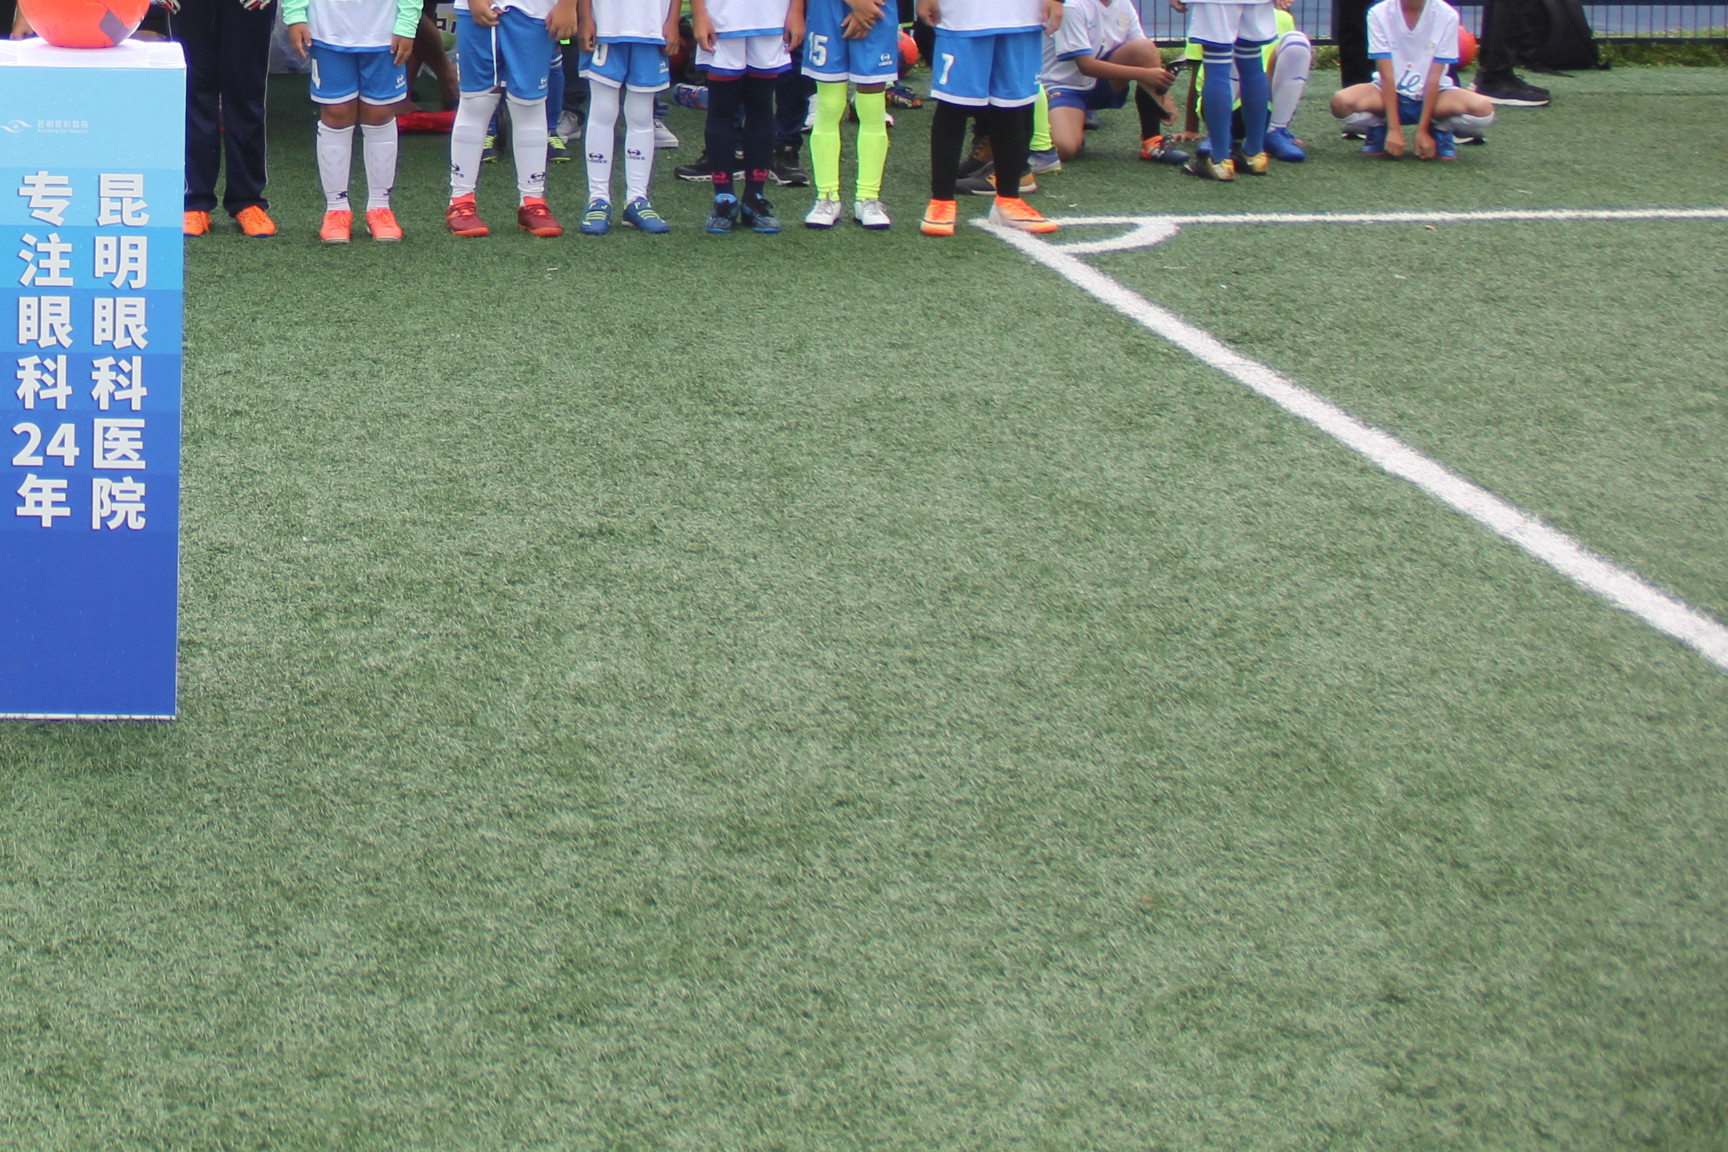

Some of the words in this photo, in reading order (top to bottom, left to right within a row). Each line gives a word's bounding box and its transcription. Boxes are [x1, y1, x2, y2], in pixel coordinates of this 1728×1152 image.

[809, 31, 829, 67] 15
[938, 53, 955, 85] 7
[12, 170, 80, 528] 专注眼科24年
[91, 173, 150, 530] 昆明眼科医院
